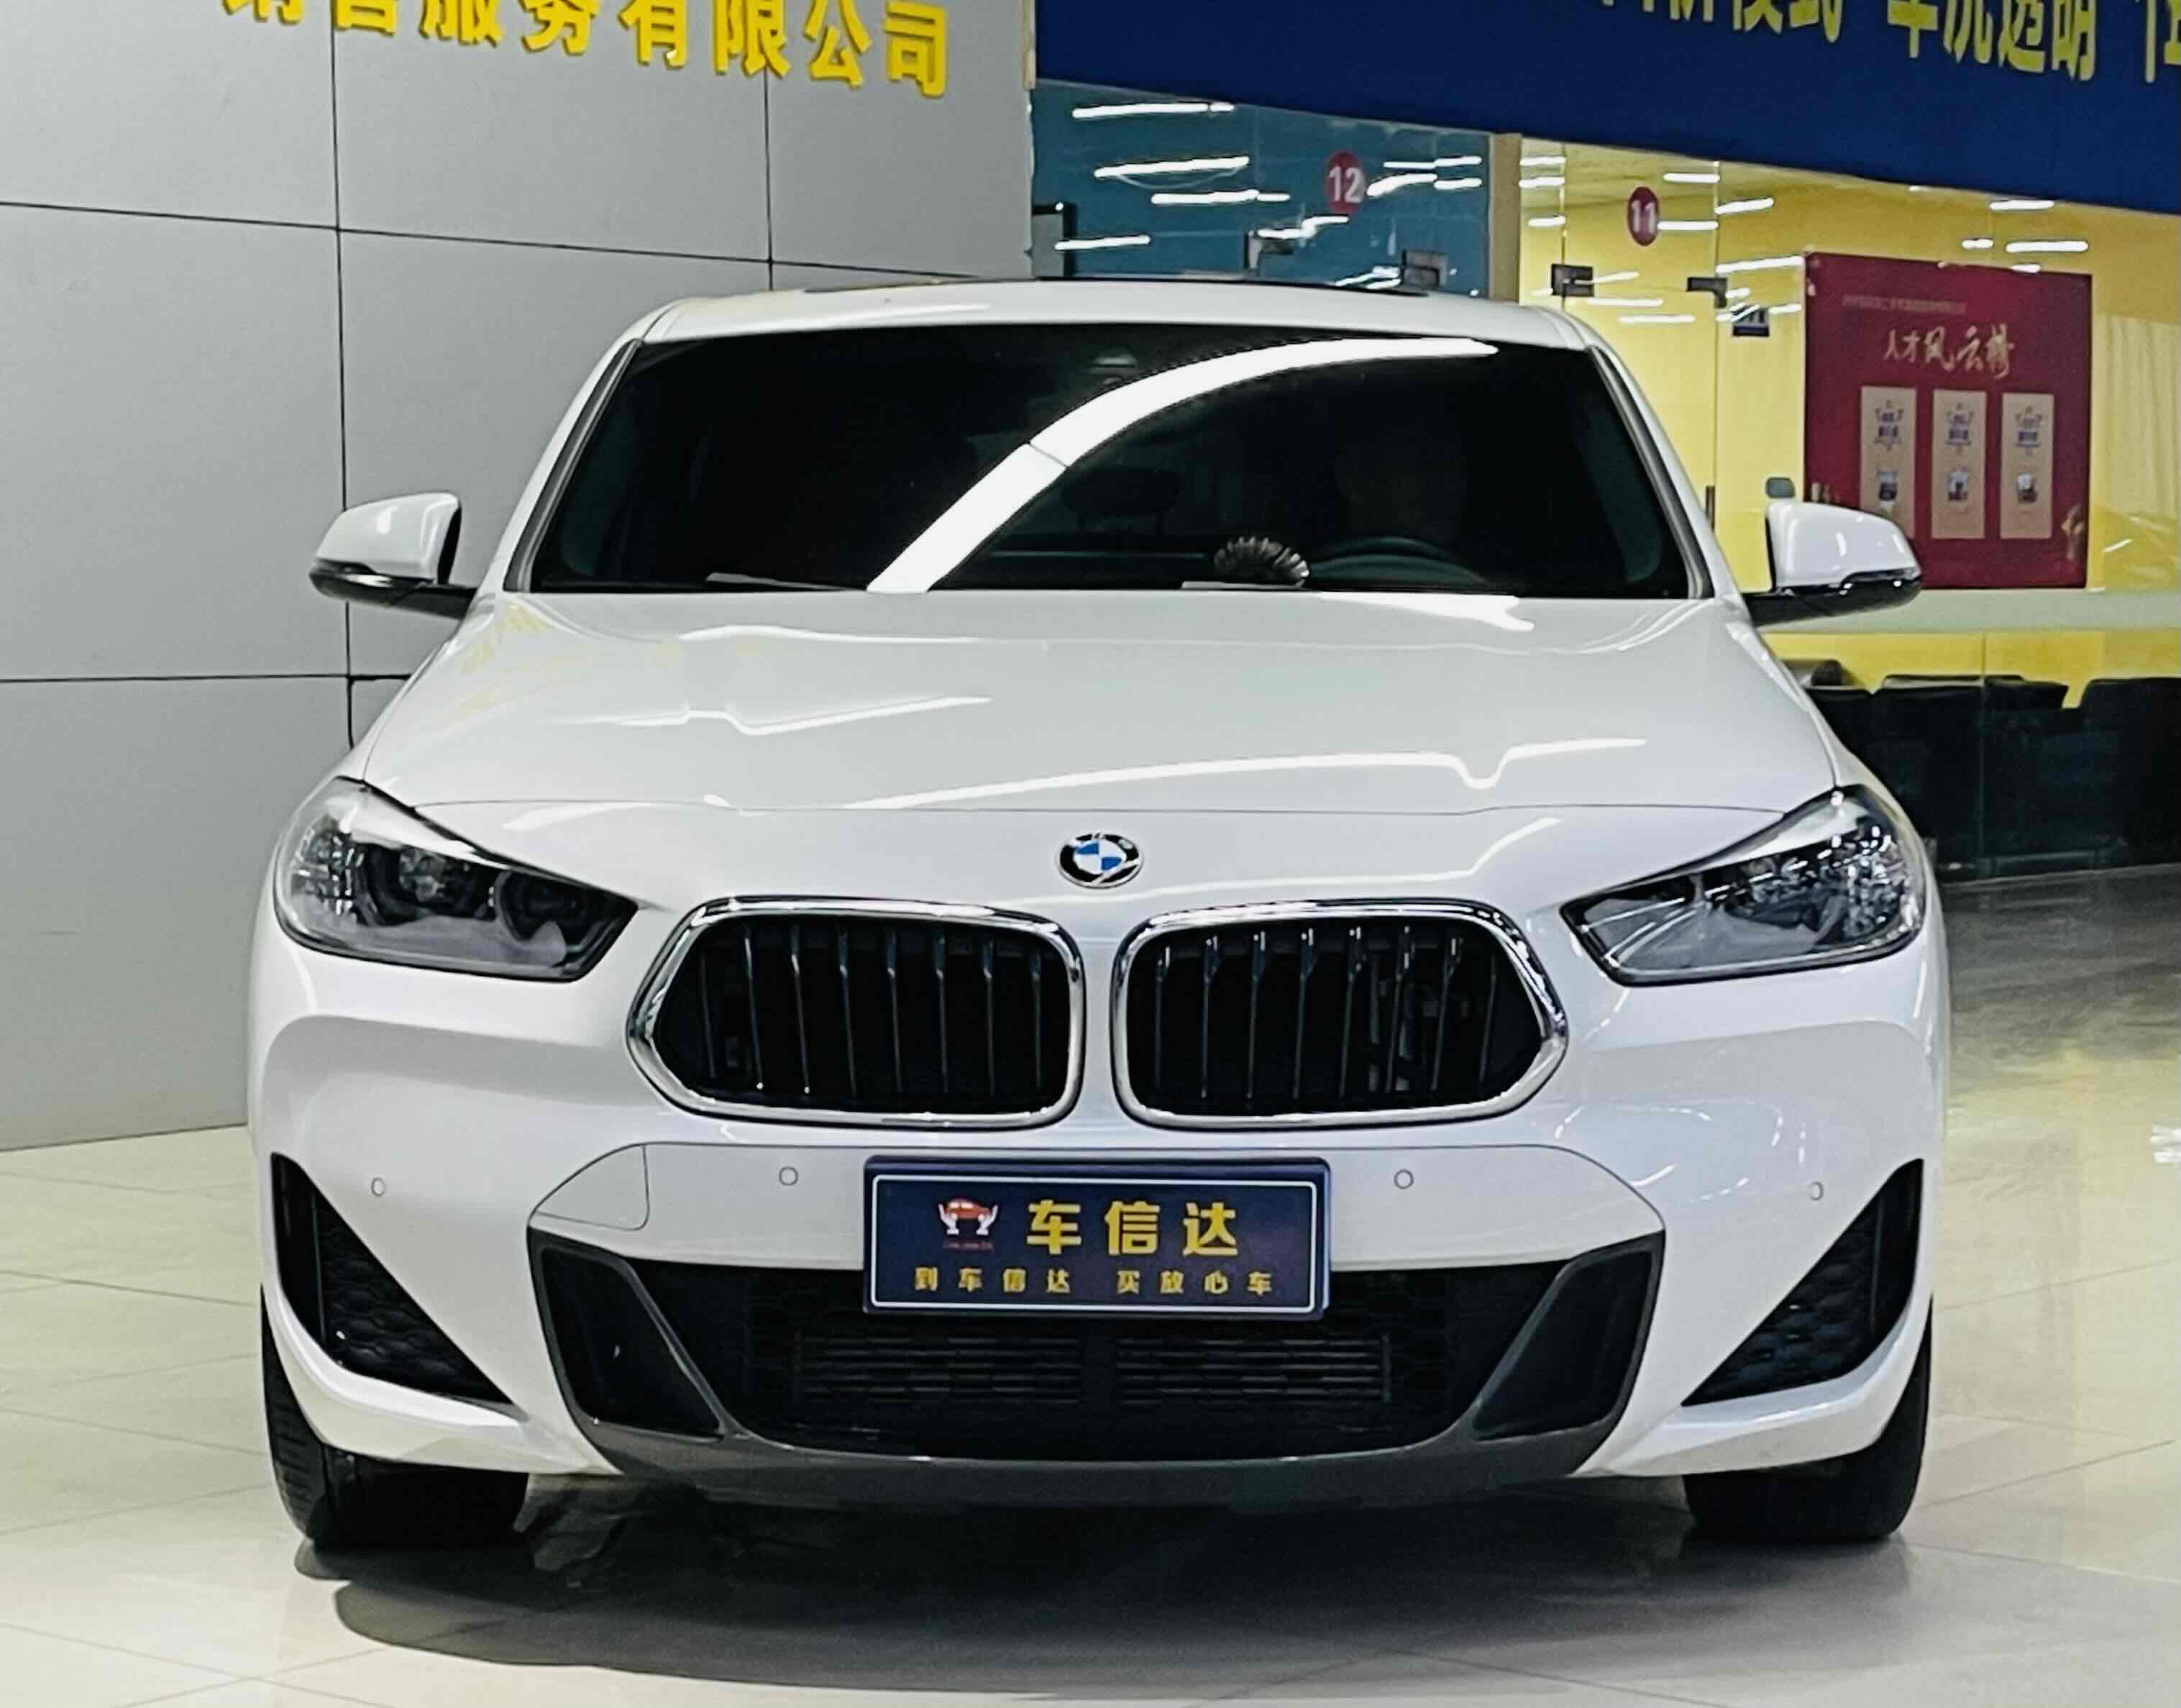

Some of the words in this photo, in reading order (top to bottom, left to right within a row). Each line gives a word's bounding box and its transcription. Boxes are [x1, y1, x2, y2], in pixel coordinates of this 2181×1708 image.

[221, 0, 948, 99] 务有限公司
[1328, 165, 1364, 204] 12
[1631, 200, 1656, 233] 11
[1026, 1197, 1239, 1257] 车信达
[915, 1266, 1071, 1294] 到车信达
[1117, 1269, 1273, 1296] 买放心车
